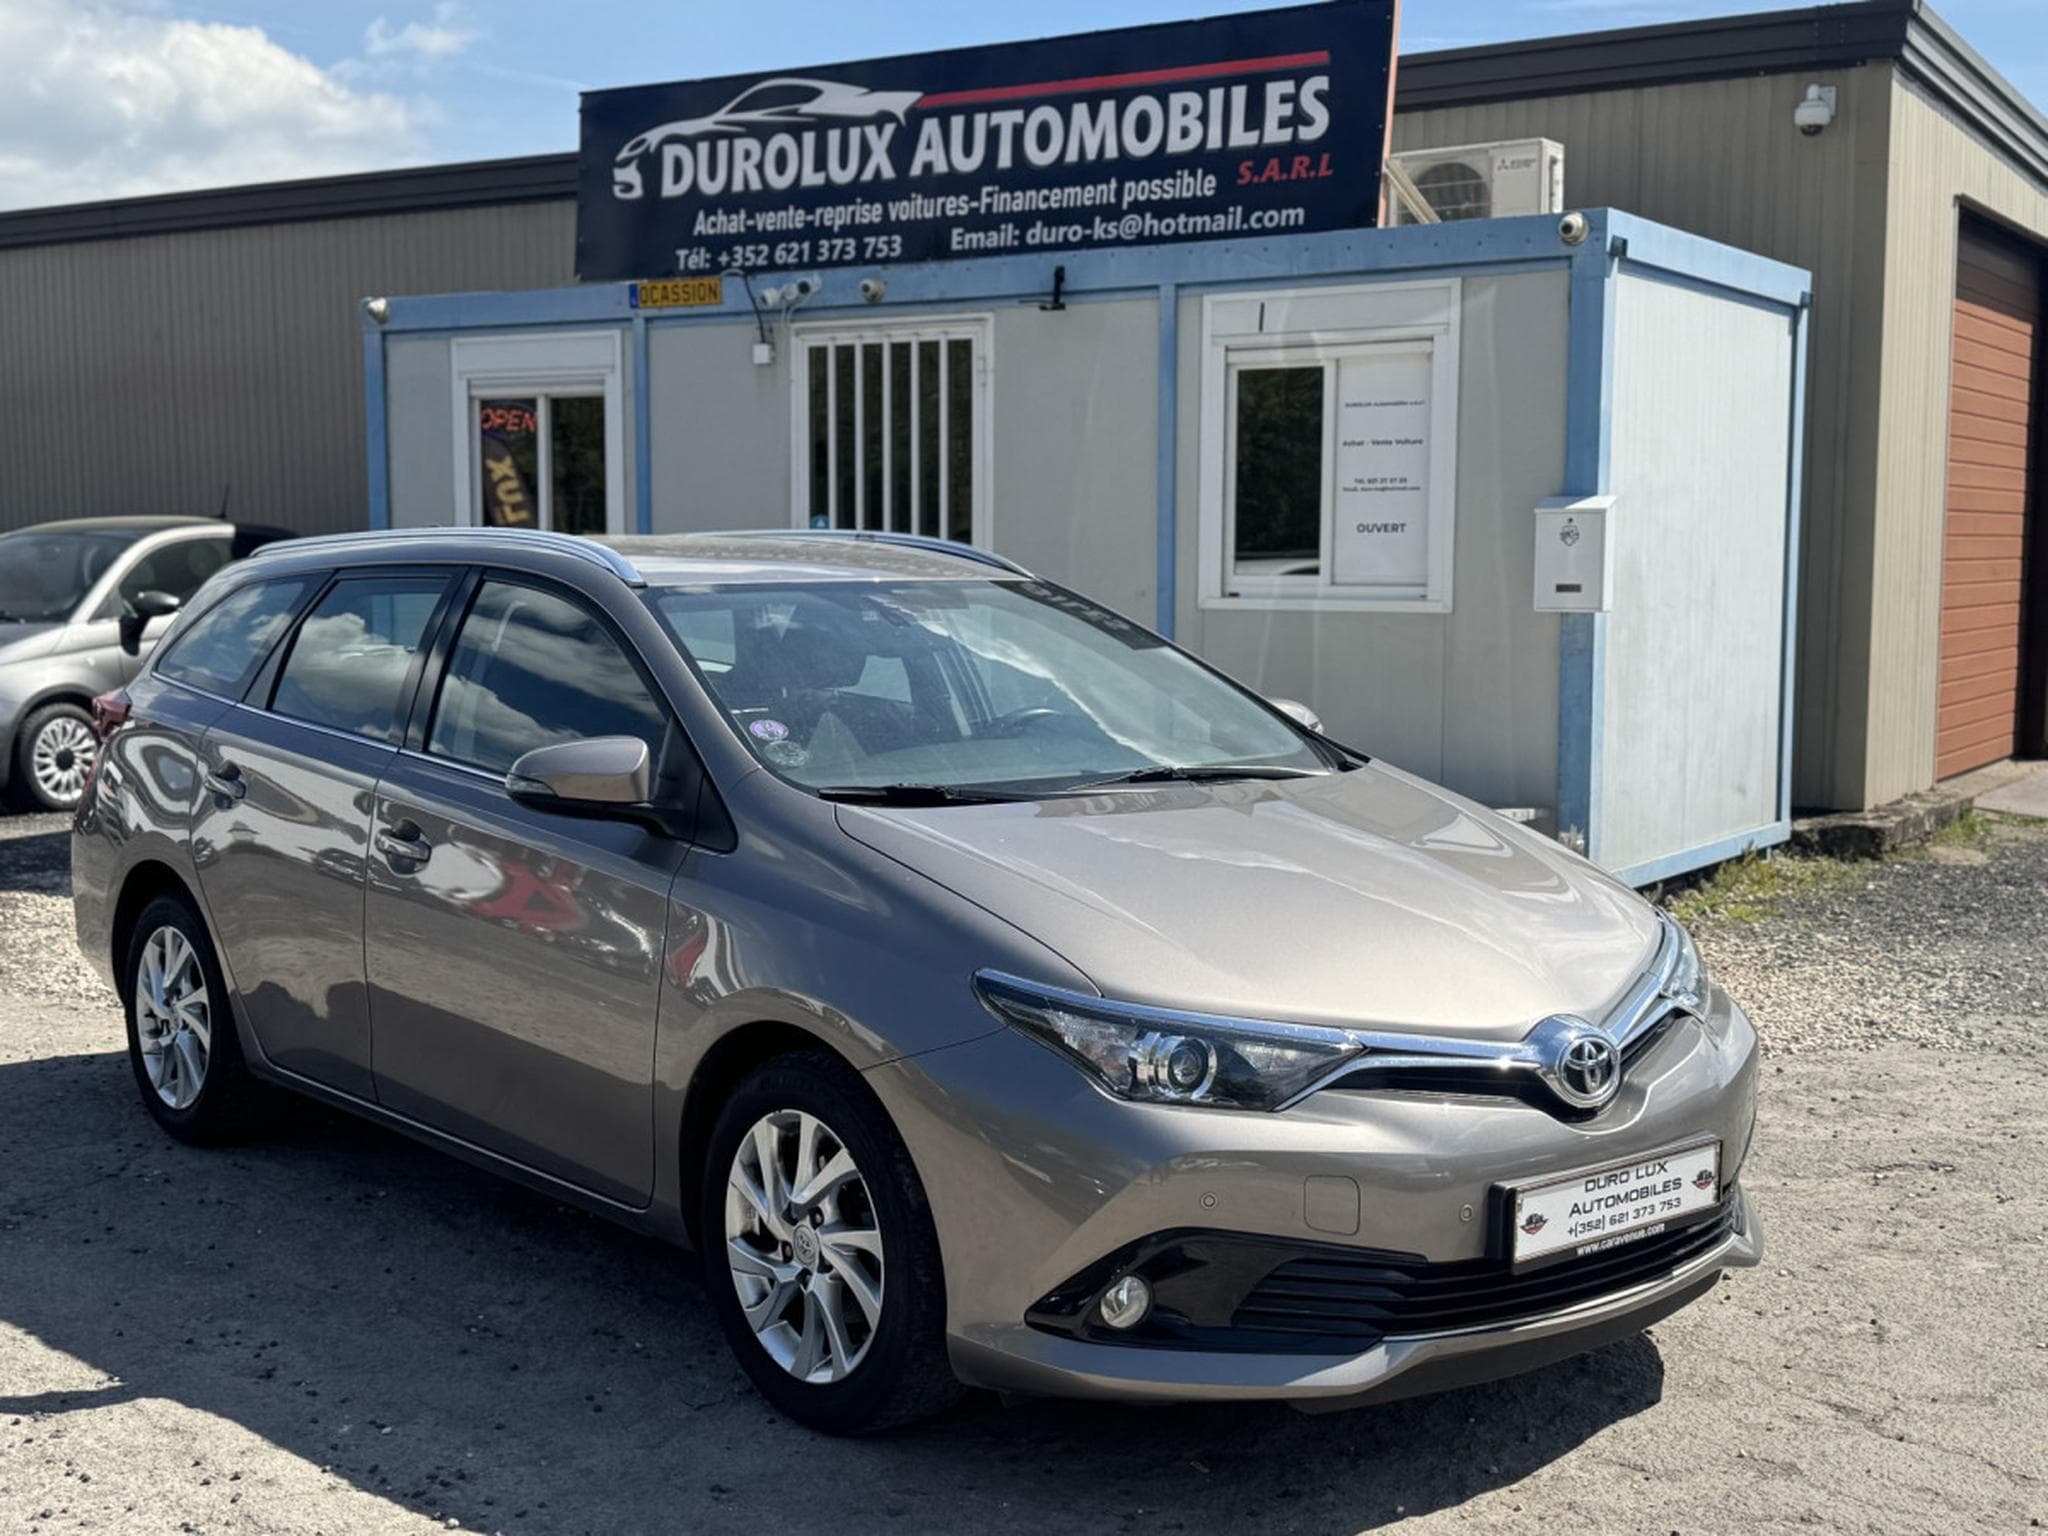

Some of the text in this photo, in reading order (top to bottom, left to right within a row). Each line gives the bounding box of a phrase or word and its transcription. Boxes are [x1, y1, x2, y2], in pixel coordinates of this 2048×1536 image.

[660, 75, 1330, 198] DUROLUX AUTOMOBILES
[1236, 153, 1333, 185] S.A.R.L
[692, 168, 1217, 237] Achat-vente-reprise voitures-Financement possible
[950, 206, 1305, 251] Email: duro-ks@hotmail.com
[675, 234, 902, 271] Tél: +352 621 373 753
[639, 282, 719, 304] OCASSION
[481, 407, 537, 432] OPEN
[1356, 522, 1407, 534] OUVERT
[1584, 1160, 1669, 1193] DURO LUX
[1568, 1177, 1683, 1218] AUTOMOBILES
[1609, 1211, 1630, 1226] 621
[1633, 1204, 1656, 1221] 373
[1660, 1197, 1682, 1214] 753
